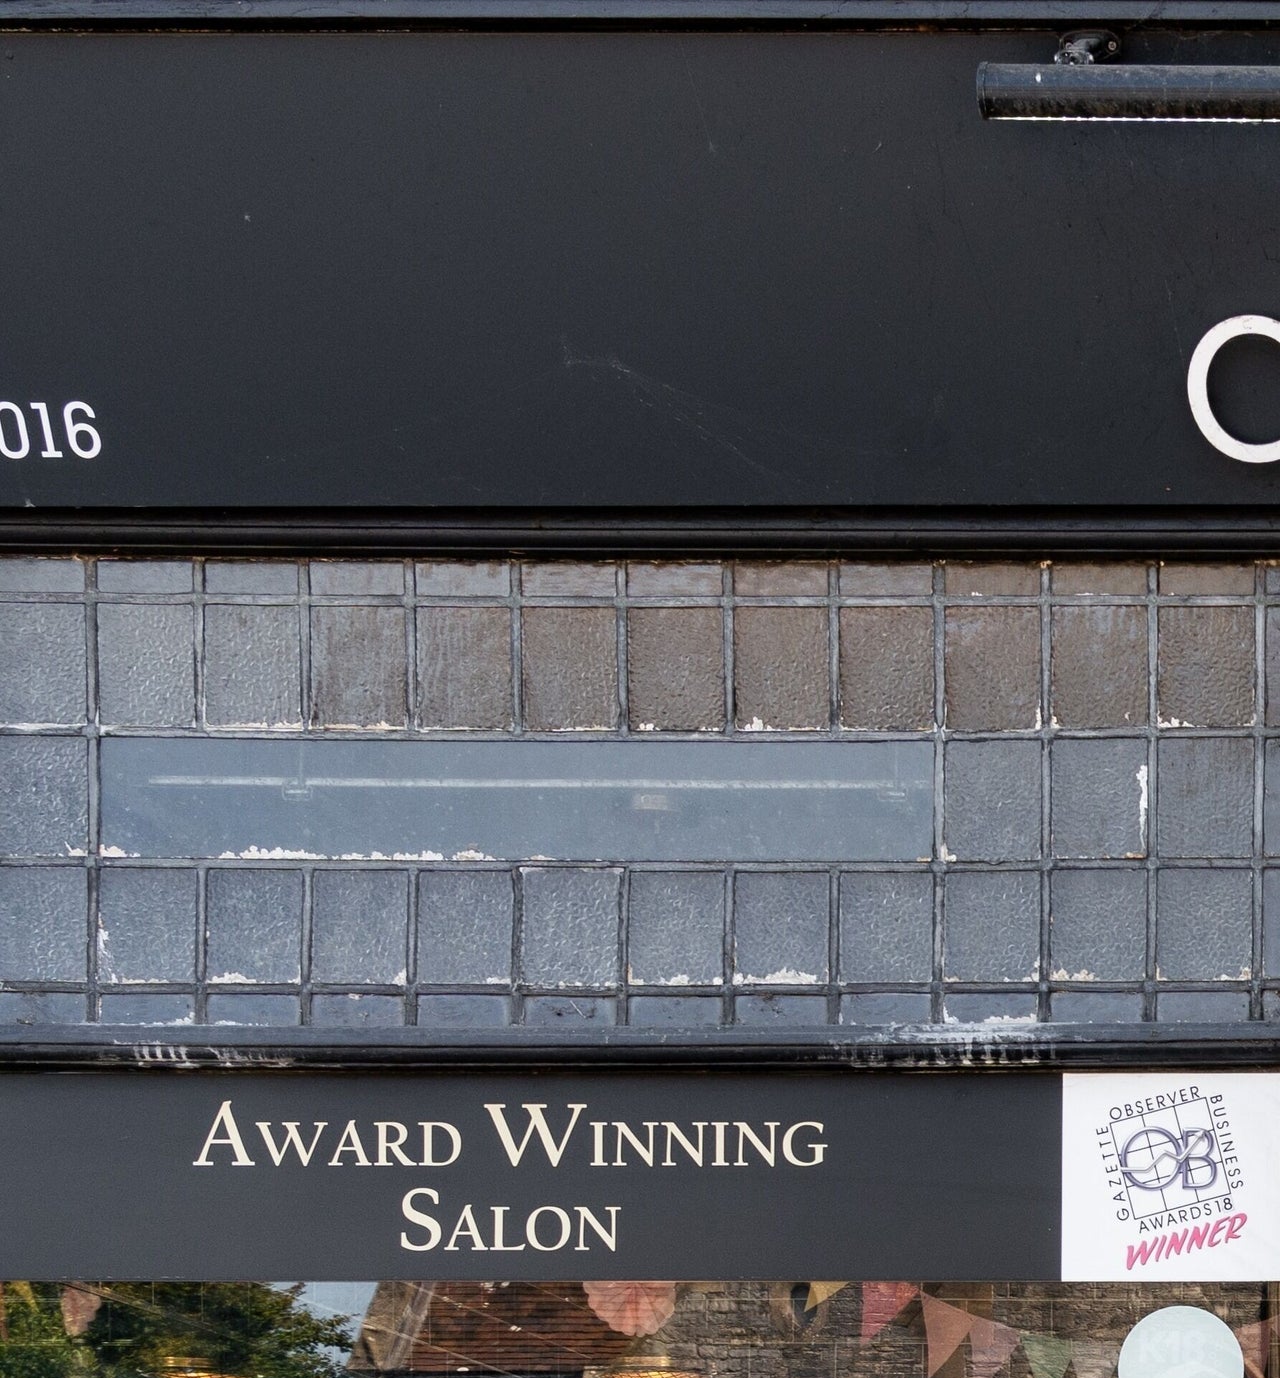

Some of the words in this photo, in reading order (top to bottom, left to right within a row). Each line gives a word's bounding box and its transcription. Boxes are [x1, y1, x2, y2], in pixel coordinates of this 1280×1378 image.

[193, 1101, 462, 1167] AWARD
[483, 1103, 828, 1168] WINNING
[1109, 1086, 1200, 1121] OBSERVER
[1096, 1125, 1130, 1221] GAZETTE
[1210, 1094, 1244, 1190] BUSINESS
[400, 1187, 622, 1252] SALON
[1126, 1212, 1248, 1271] WINNER
